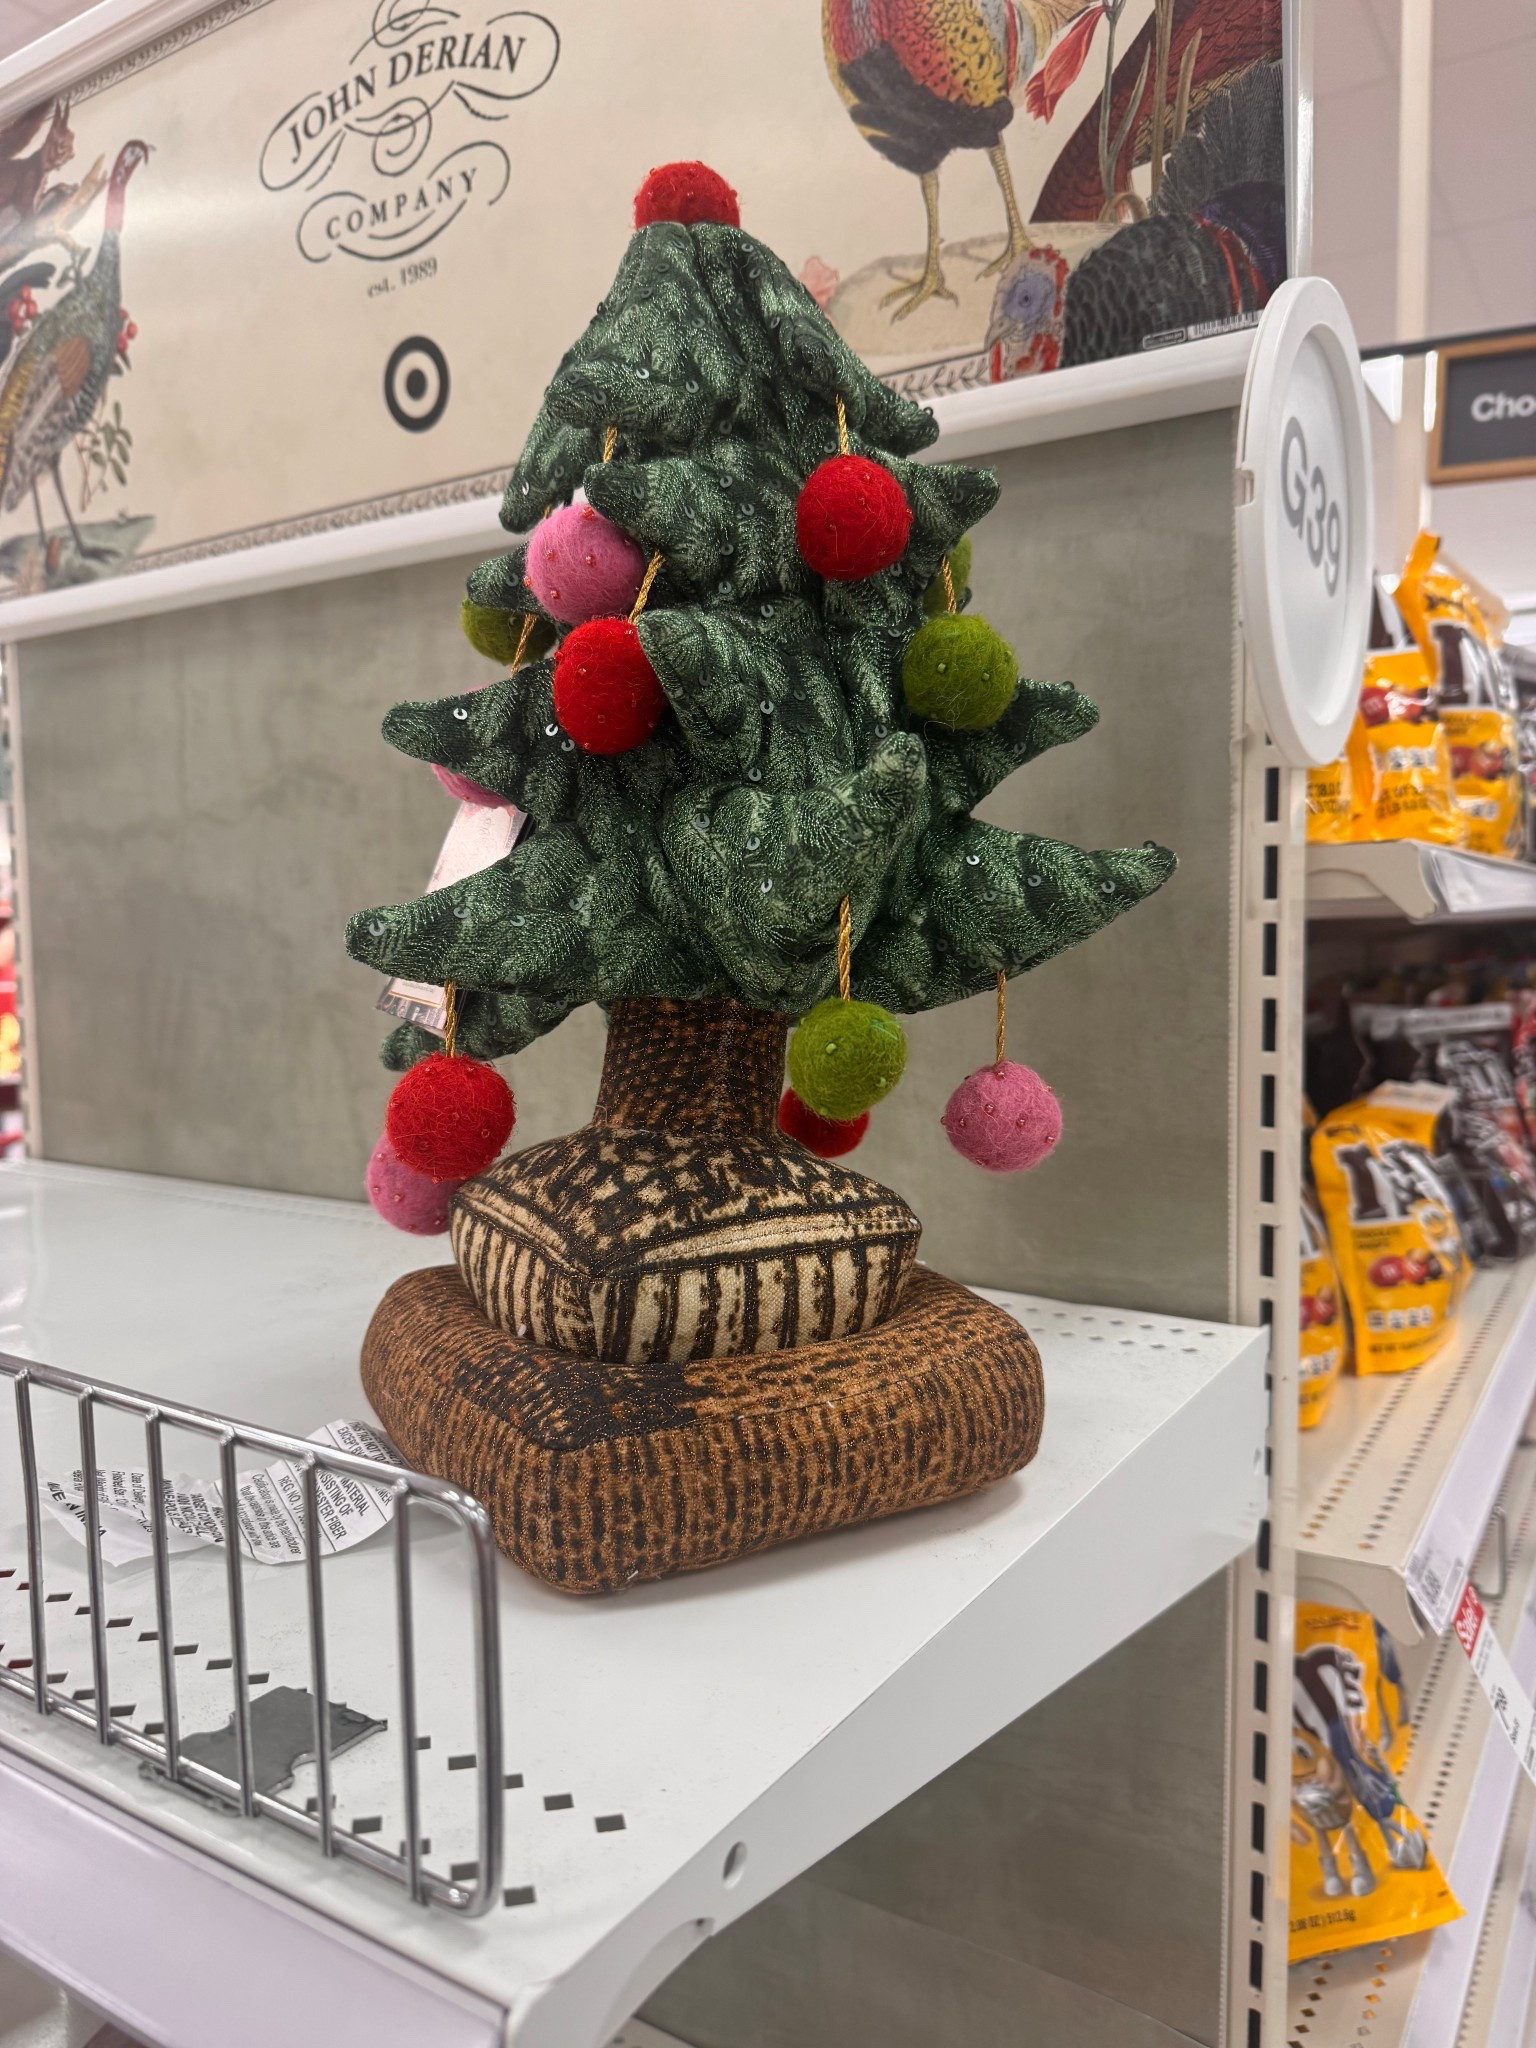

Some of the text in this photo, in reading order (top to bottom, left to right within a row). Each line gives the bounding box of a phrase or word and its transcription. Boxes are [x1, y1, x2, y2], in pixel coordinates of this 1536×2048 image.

[288, 32, 527, 164] JOHN DERIAN
[326, 168, 477, 240] COMPANY
[367, 256, 439, 298] est. 1989
[1471, 391, 1536, 422] Cho
[1281, 416, 1341, 598] G39
[337, 1426, 360, 1450] EXCEPT
[317, 1470, 354, 1516] NSISTING OF
[340, 1477, 370, 1517] MATERIAL
[326, 1515, 347, 1540] FIBER
